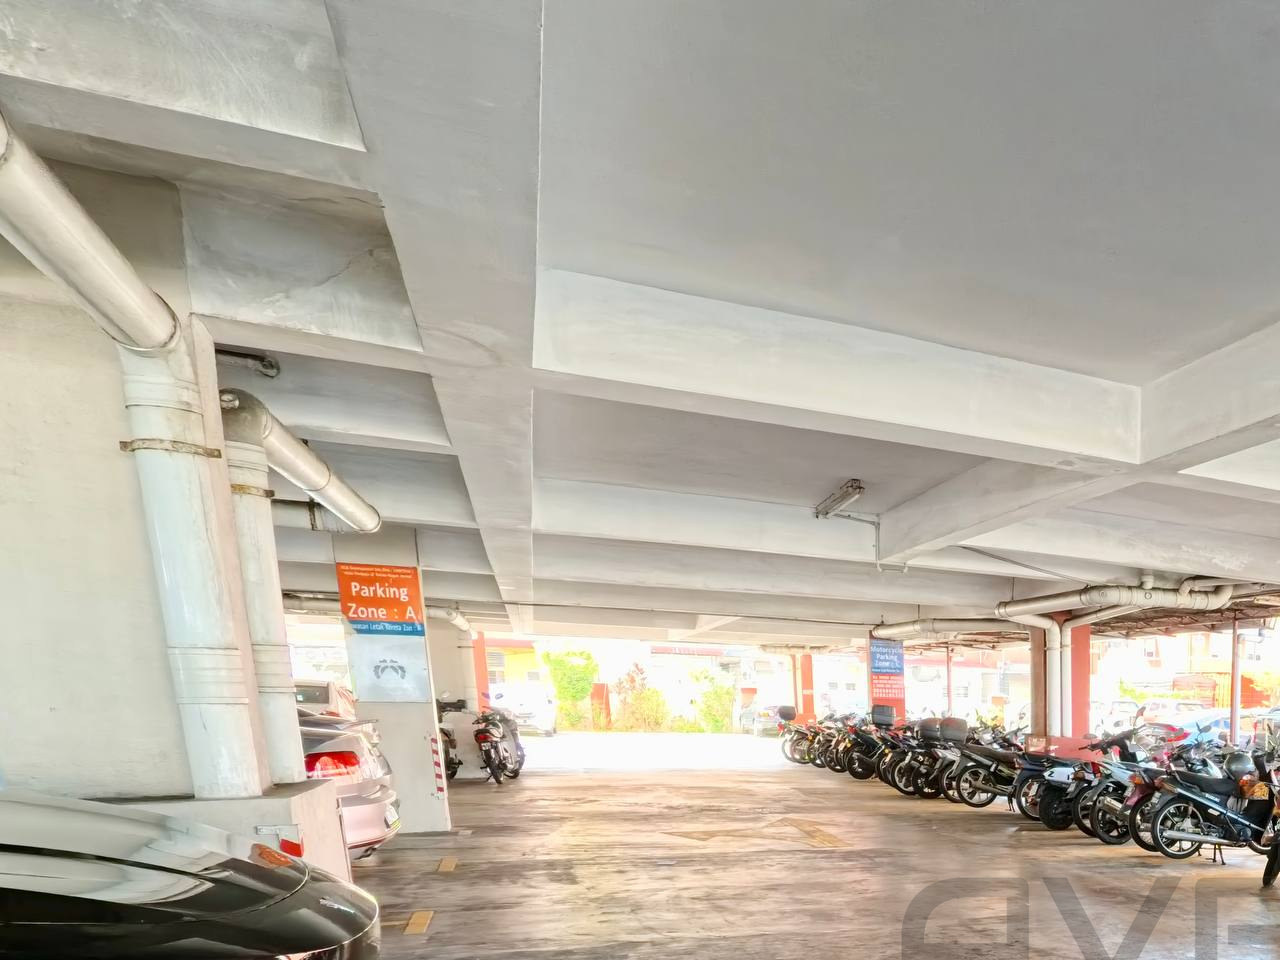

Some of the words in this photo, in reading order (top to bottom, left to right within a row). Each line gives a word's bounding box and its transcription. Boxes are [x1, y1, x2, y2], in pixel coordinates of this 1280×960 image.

[351, 582, 409, 602] Parking
[347, 603, 387, 619] Zone
[405, 607, 416, 619] A
[870, 646, 903, 655] Motorcycle
